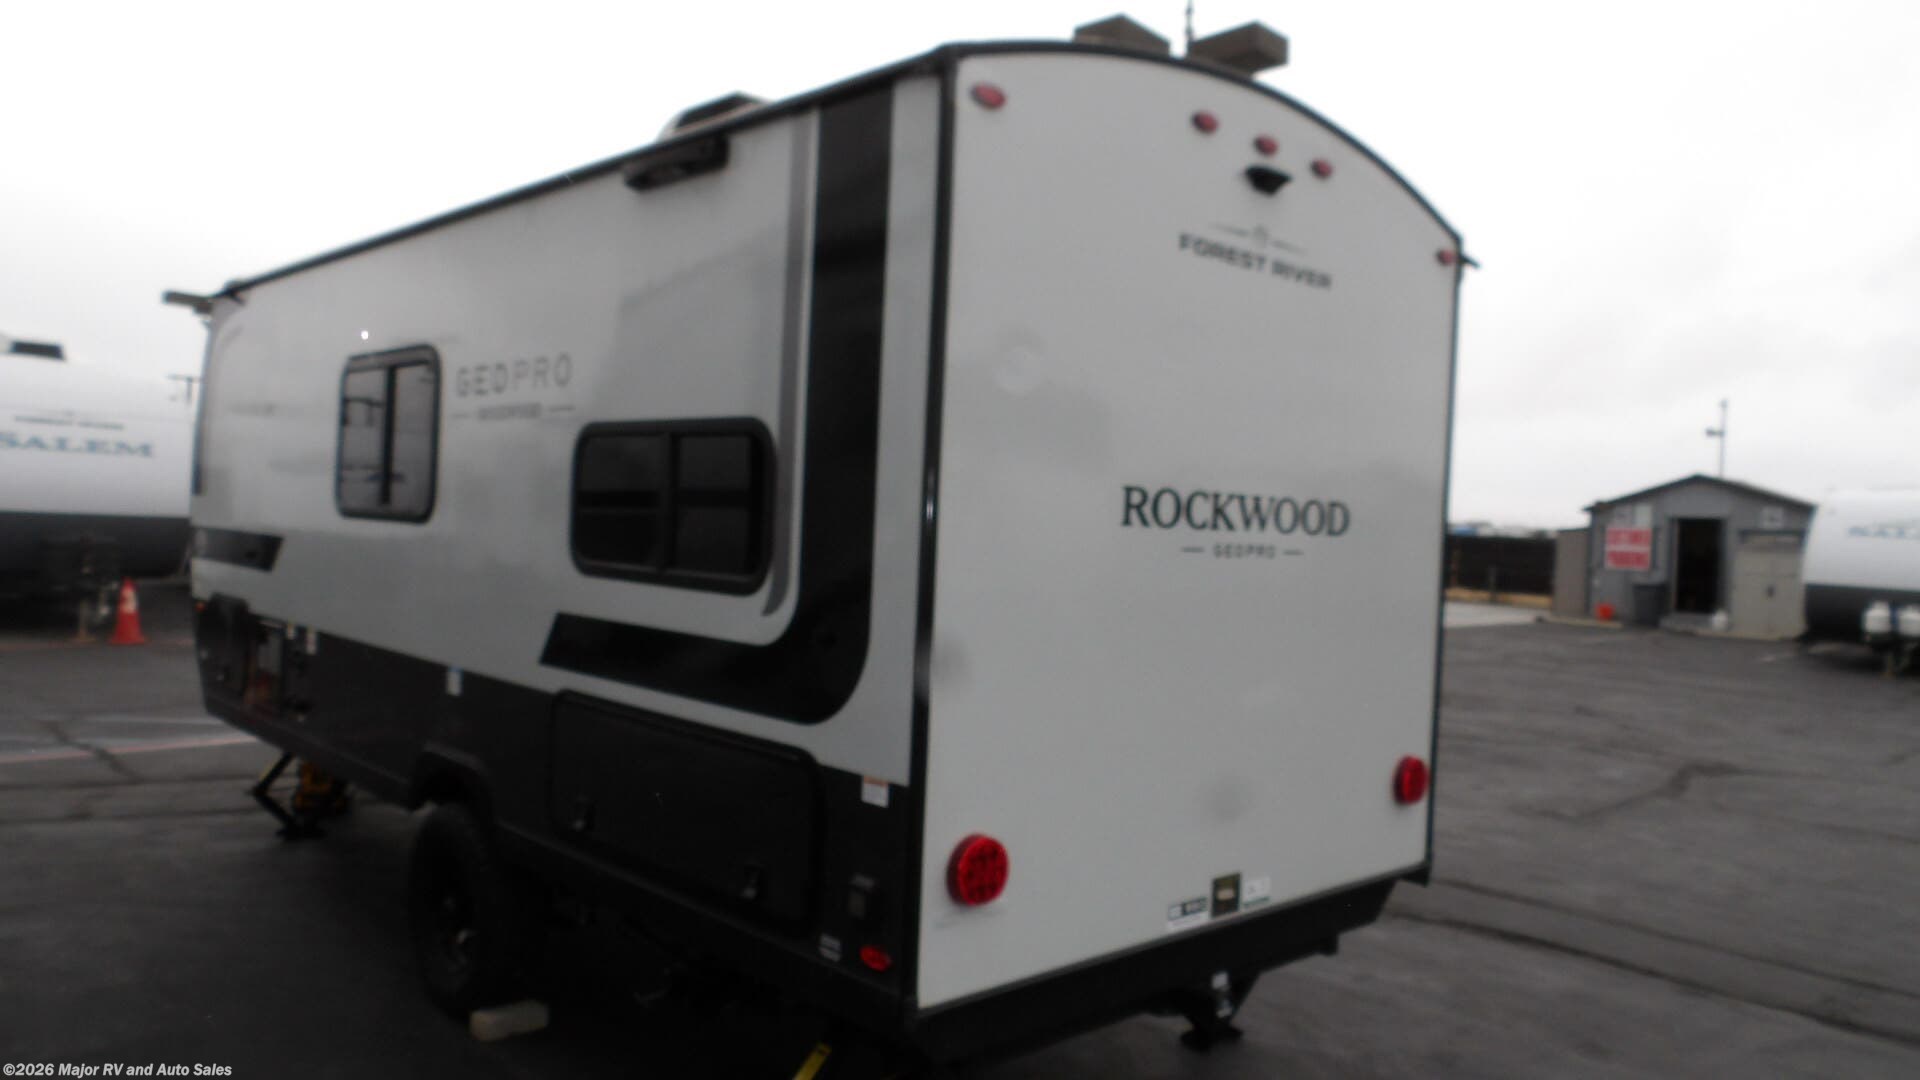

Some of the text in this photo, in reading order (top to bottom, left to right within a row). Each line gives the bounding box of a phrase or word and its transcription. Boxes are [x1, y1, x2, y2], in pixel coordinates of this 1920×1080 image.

[1179, 233, 1333, 289] FOREST RIVER
[0, 431, 153, 457] SALEM
[1121, 485, 1351, 537] ROCKWOOD
